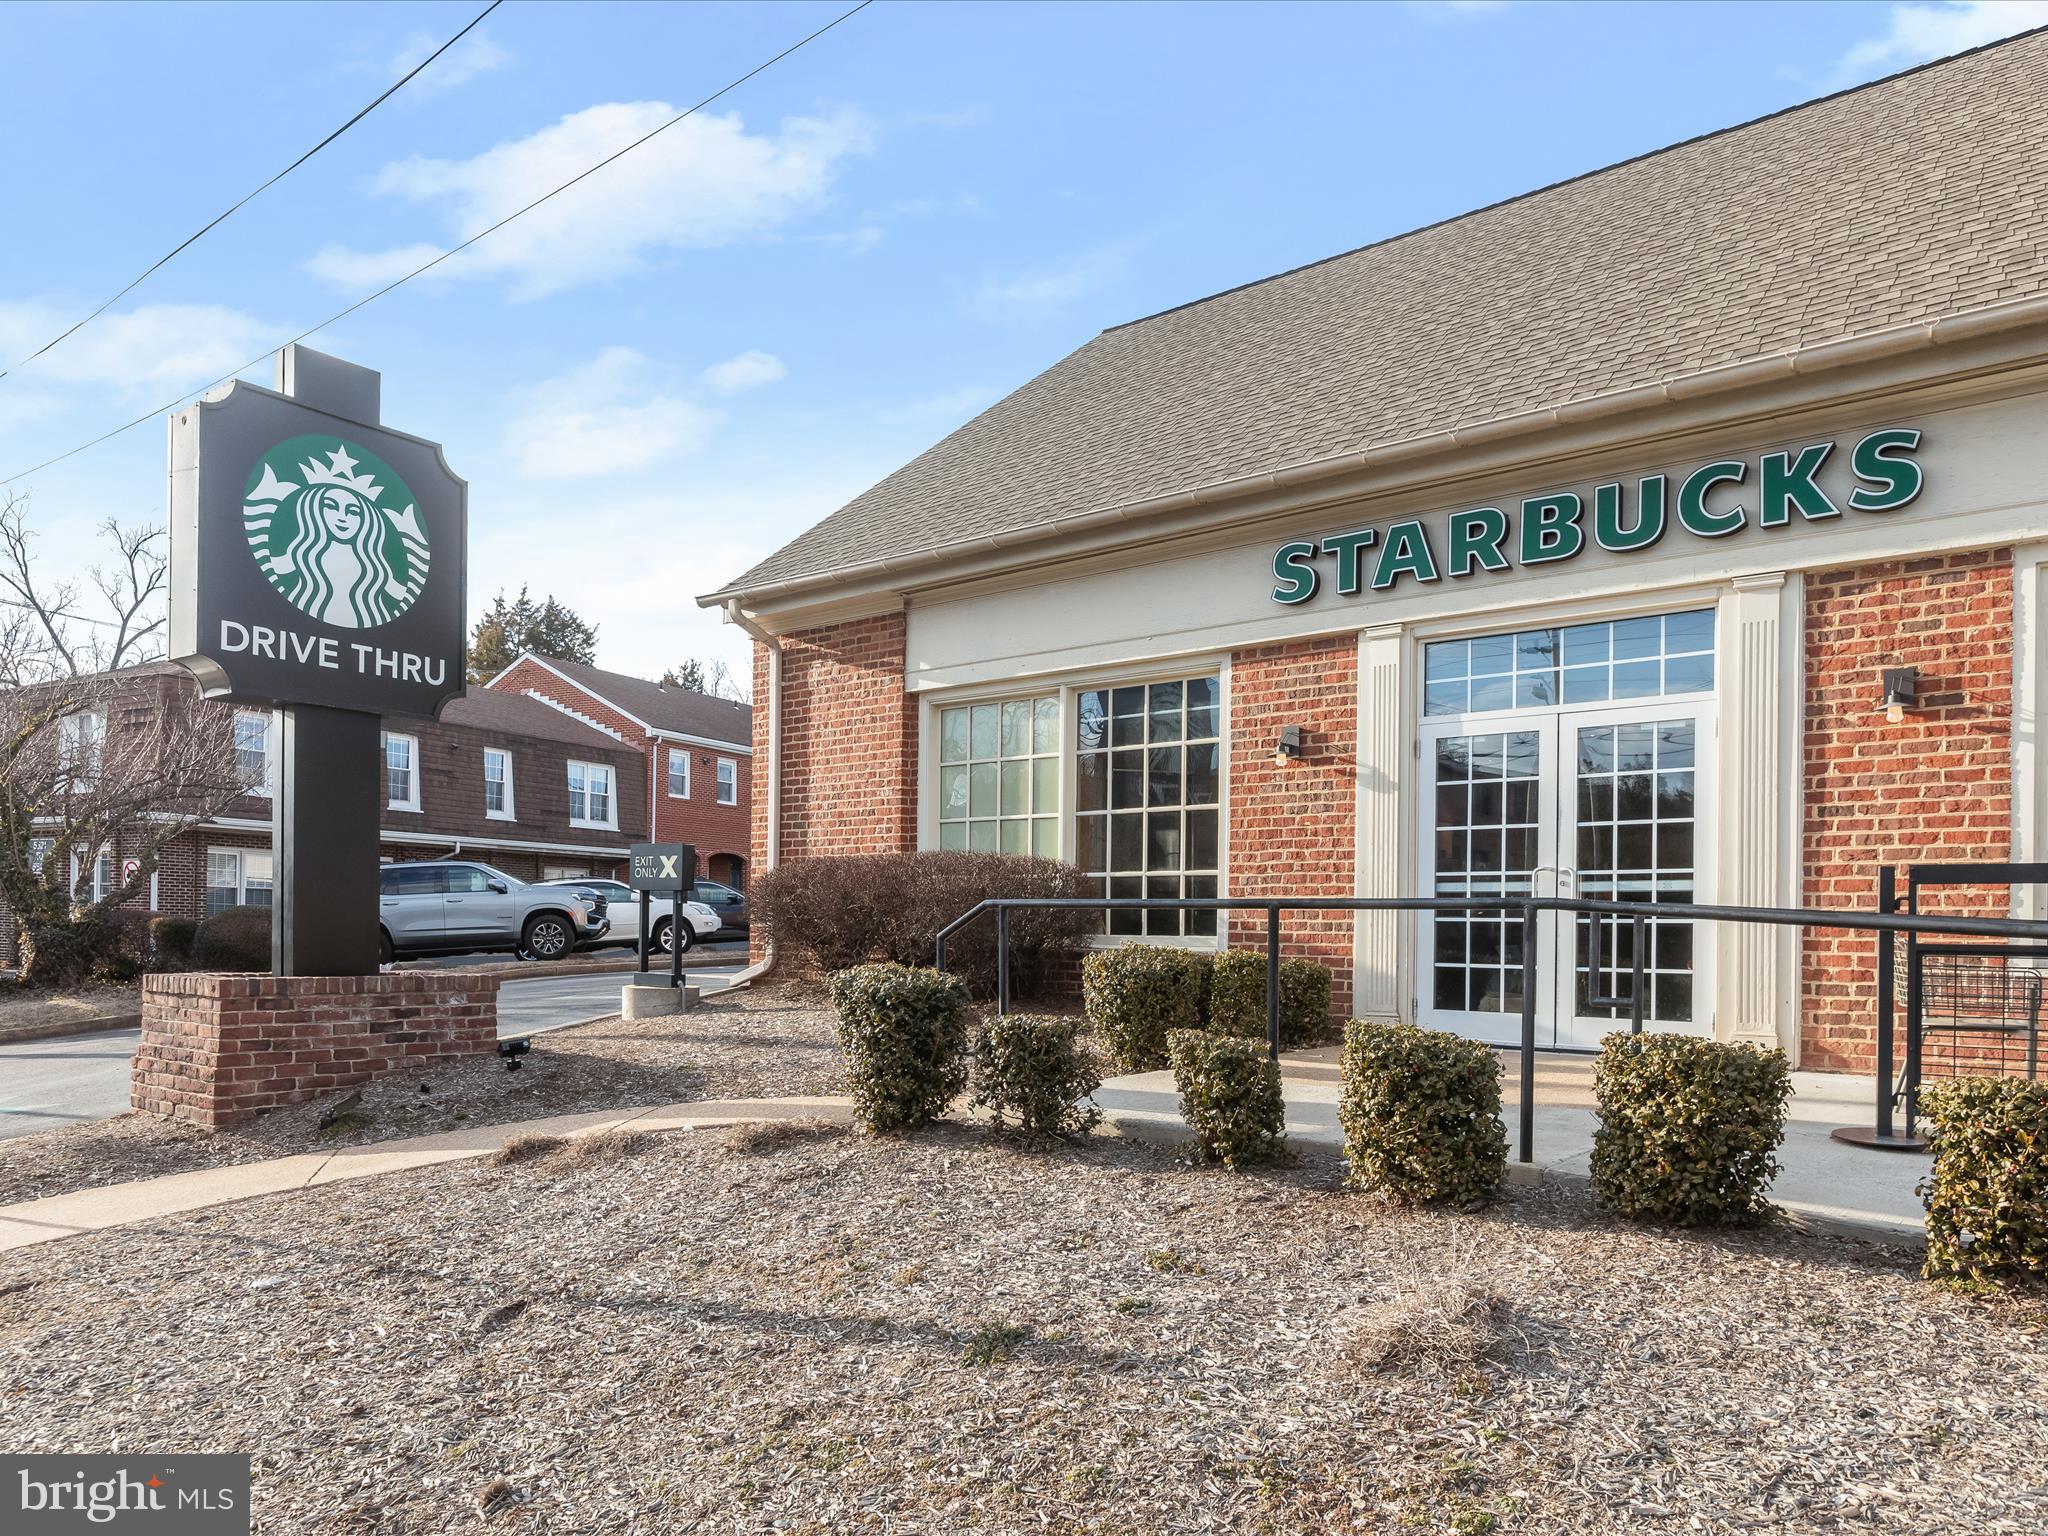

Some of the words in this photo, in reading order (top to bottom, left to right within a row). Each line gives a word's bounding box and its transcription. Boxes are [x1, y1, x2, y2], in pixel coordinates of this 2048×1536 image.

[1271, 428, 1926, 604] STARBUCKS
[220, 619, 339, 669] DRIVE
[351, 643, 445, 686] THRU
[634, 867, 658, 878] ONLY
[635, 856, 654, 867] EXIT
